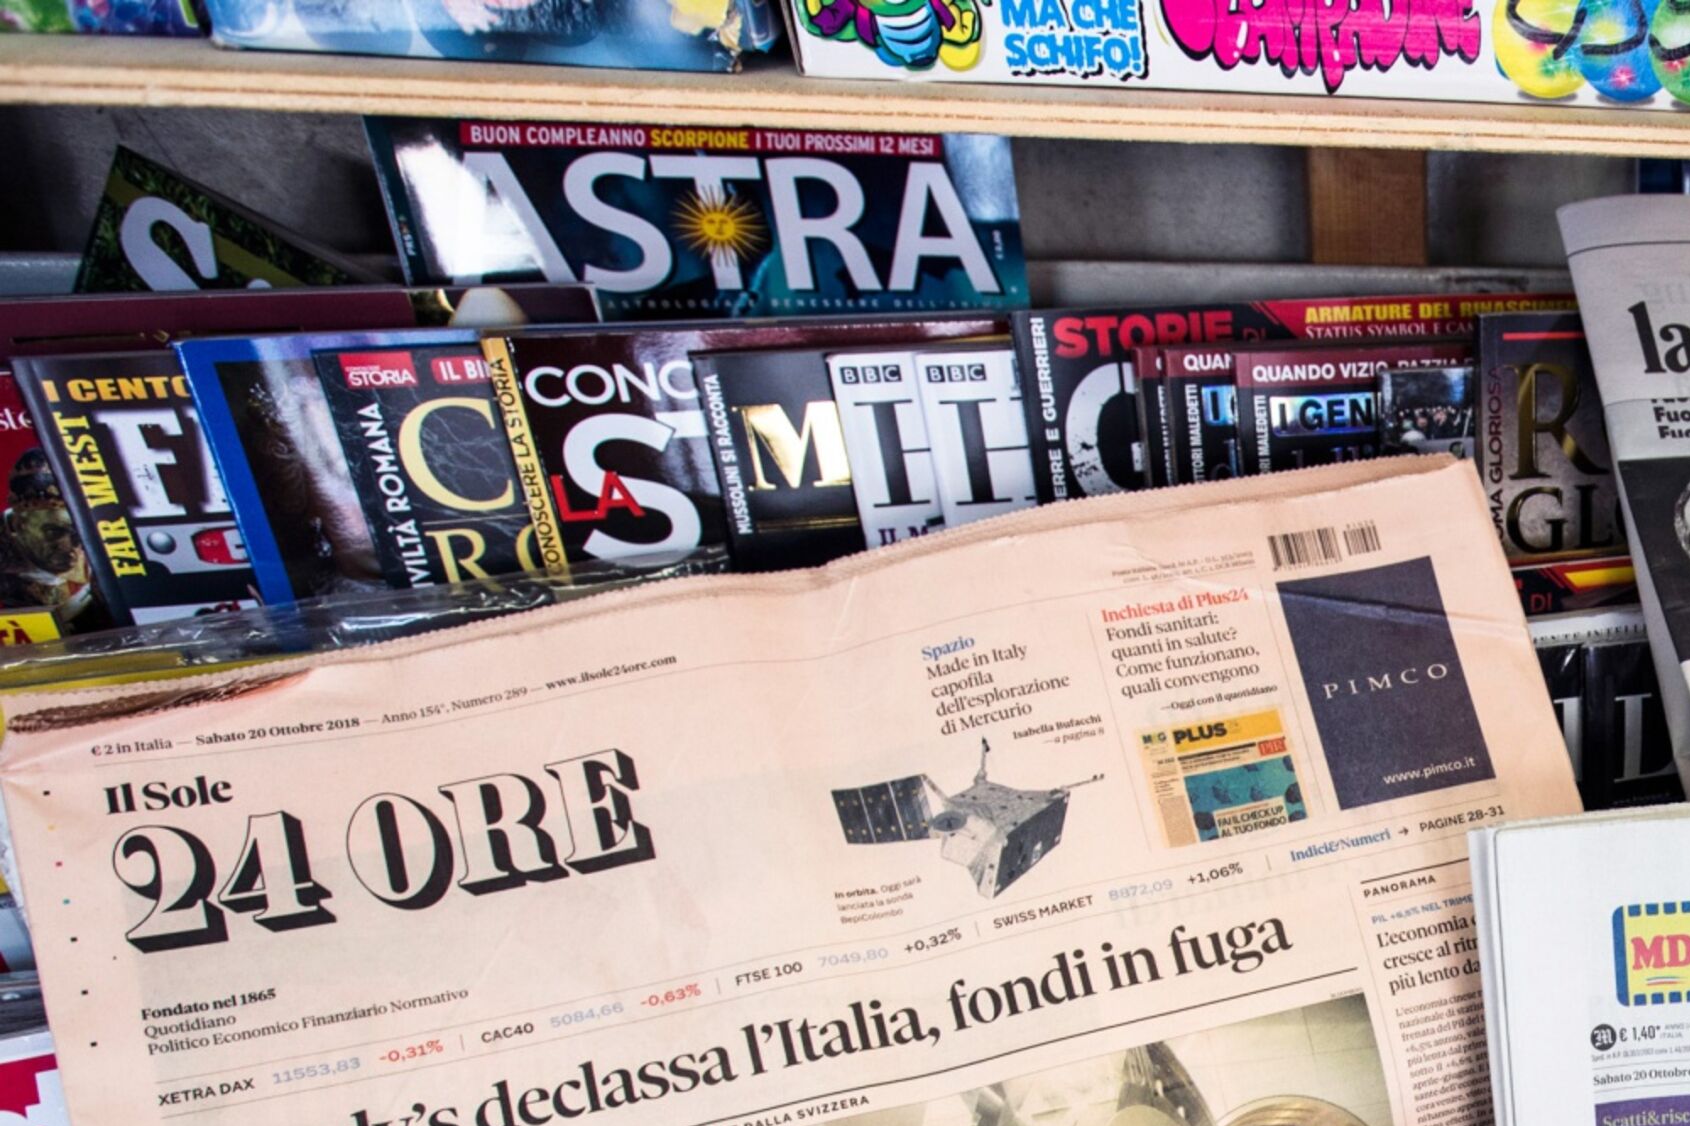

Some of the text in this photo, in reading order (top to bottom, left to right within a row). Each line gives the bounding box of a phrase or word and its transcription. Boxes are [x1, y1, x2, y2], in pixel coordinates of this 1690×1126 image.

[1005, 33, 1141, 73] SCHIFO!
[470, 126, 934, 155] BUON COMPLEANNO SCORPIONE TUOI PROSSIMI 12 MESI
[452, 151, 1001, 294] ASTRA
[1305, 304, 1411, 323] ARMATURE
[348, 368, 415, 386] STORIA
[840, 364, 902, 385] BBC
[926, 363, 987, 383] BBC
[1030, 317, 1057, 421] GUERRIERI
[1253, 365, 1335, 381] QUANDO
[495, 357, 521, 433] STORIA
[1486, 366, 1503, 481] GLORIOSA
[358, 403, 410, 512] ROMANA
[704, 373, 753, 535] MUSSOLINI RACCONTA
[53, 411, 146, 577] FAR WEST
[550, 471, 646, 521] LA
[1101, 588, 1248, 623] Inchiesta Plus24
[1155, 612, 1219, 634] sanitari:
[921, 635, 974, 660] Spazio
[931, 671, 994, 700] capofila
[1323, 663, 1448, 700] PIMCO
[196, 654, 677, 747] Sabato Ottobre 2018 www.ilsole24ore.com
[961, 702, 1032, 732] Mercurio
[1383, 757, 1475, 784] www.pimco.it
[103, 775, 233, 815] Il Sole
[113, 748, 656, 954] 24 ORE
[1363, 874, 1436, 898] PANORAMA
[948, 947, 1097, 1031] fondi
[1100, 941, 1163, 991] in
[1168, 917, 1293, 976] fuga
[141, 1001, 209, 1020] Fondato
[159, 895, 1093, 1106] XETRA DAX -0,31% CAC40 SWISS MARKET
[144, 1013, 237, 1040] Quotidiano
[148, 987, 469, 1056] Politico Economico Finanziario Normativo
